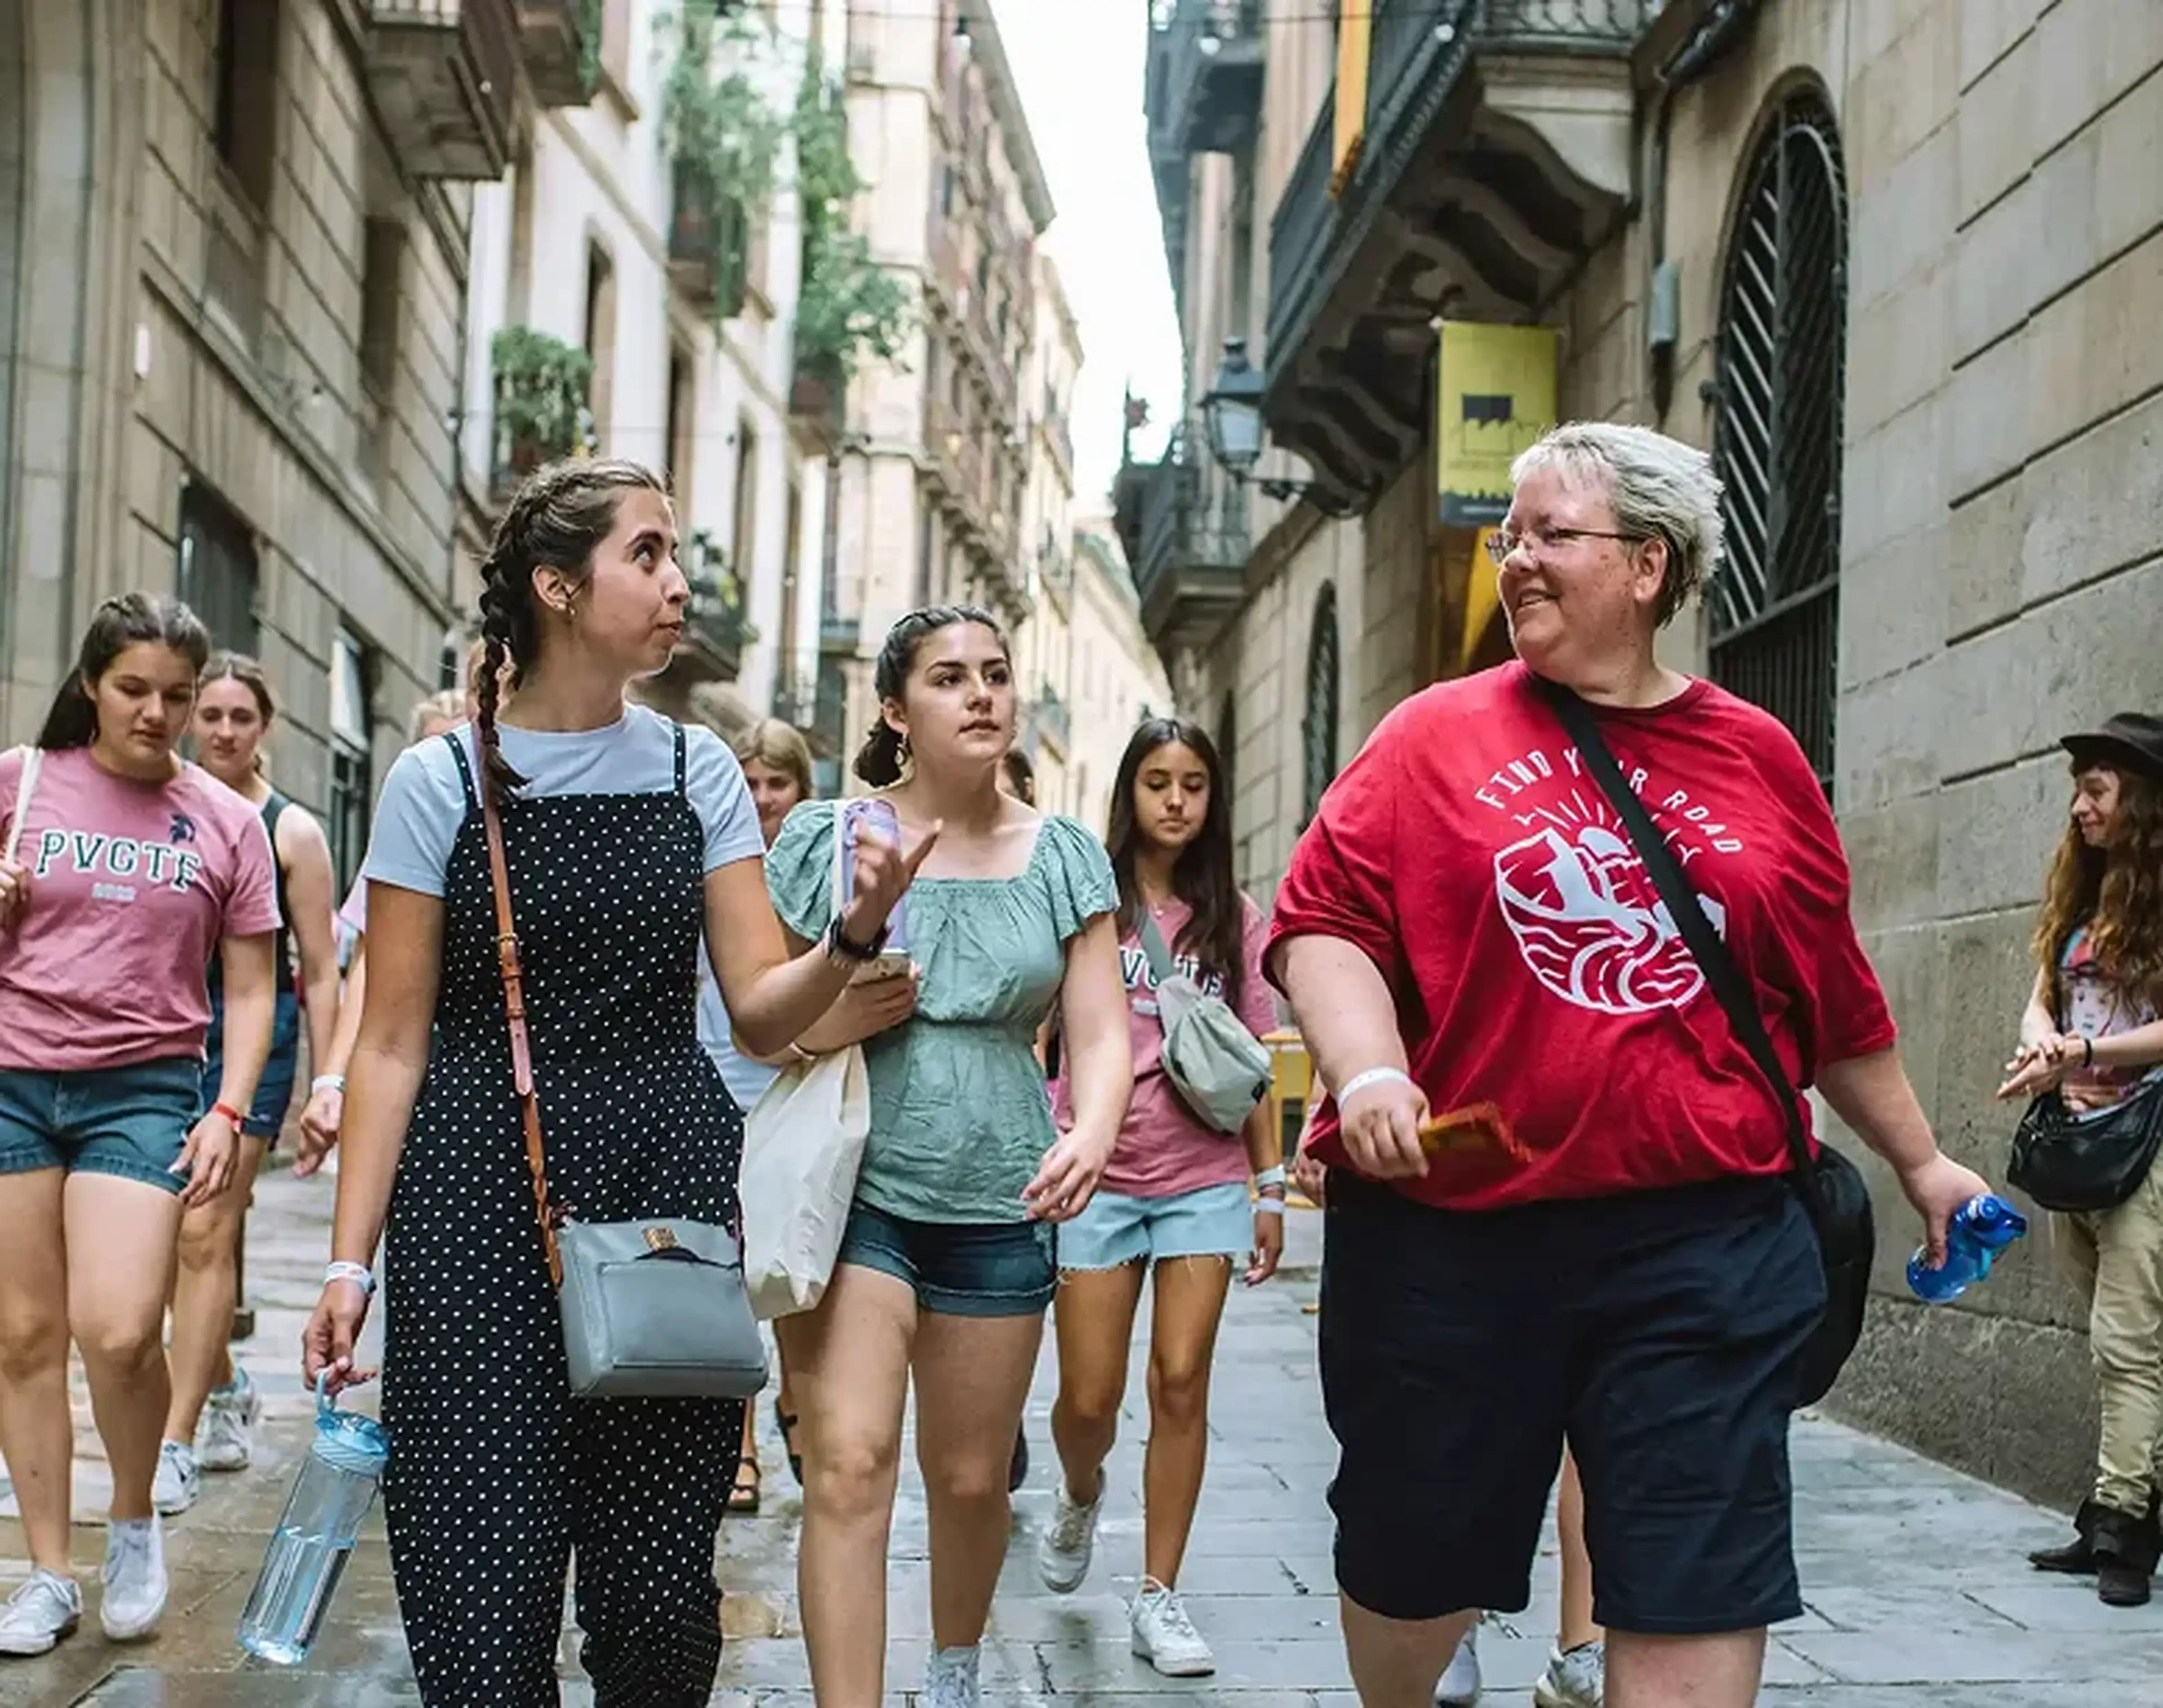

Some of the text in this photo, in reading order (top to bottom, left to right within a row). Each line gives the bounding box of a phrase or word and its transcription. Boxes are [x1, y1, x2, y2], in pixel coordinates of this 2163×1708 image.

[1475, 747, 1743, 853] FIND YR ROAD
